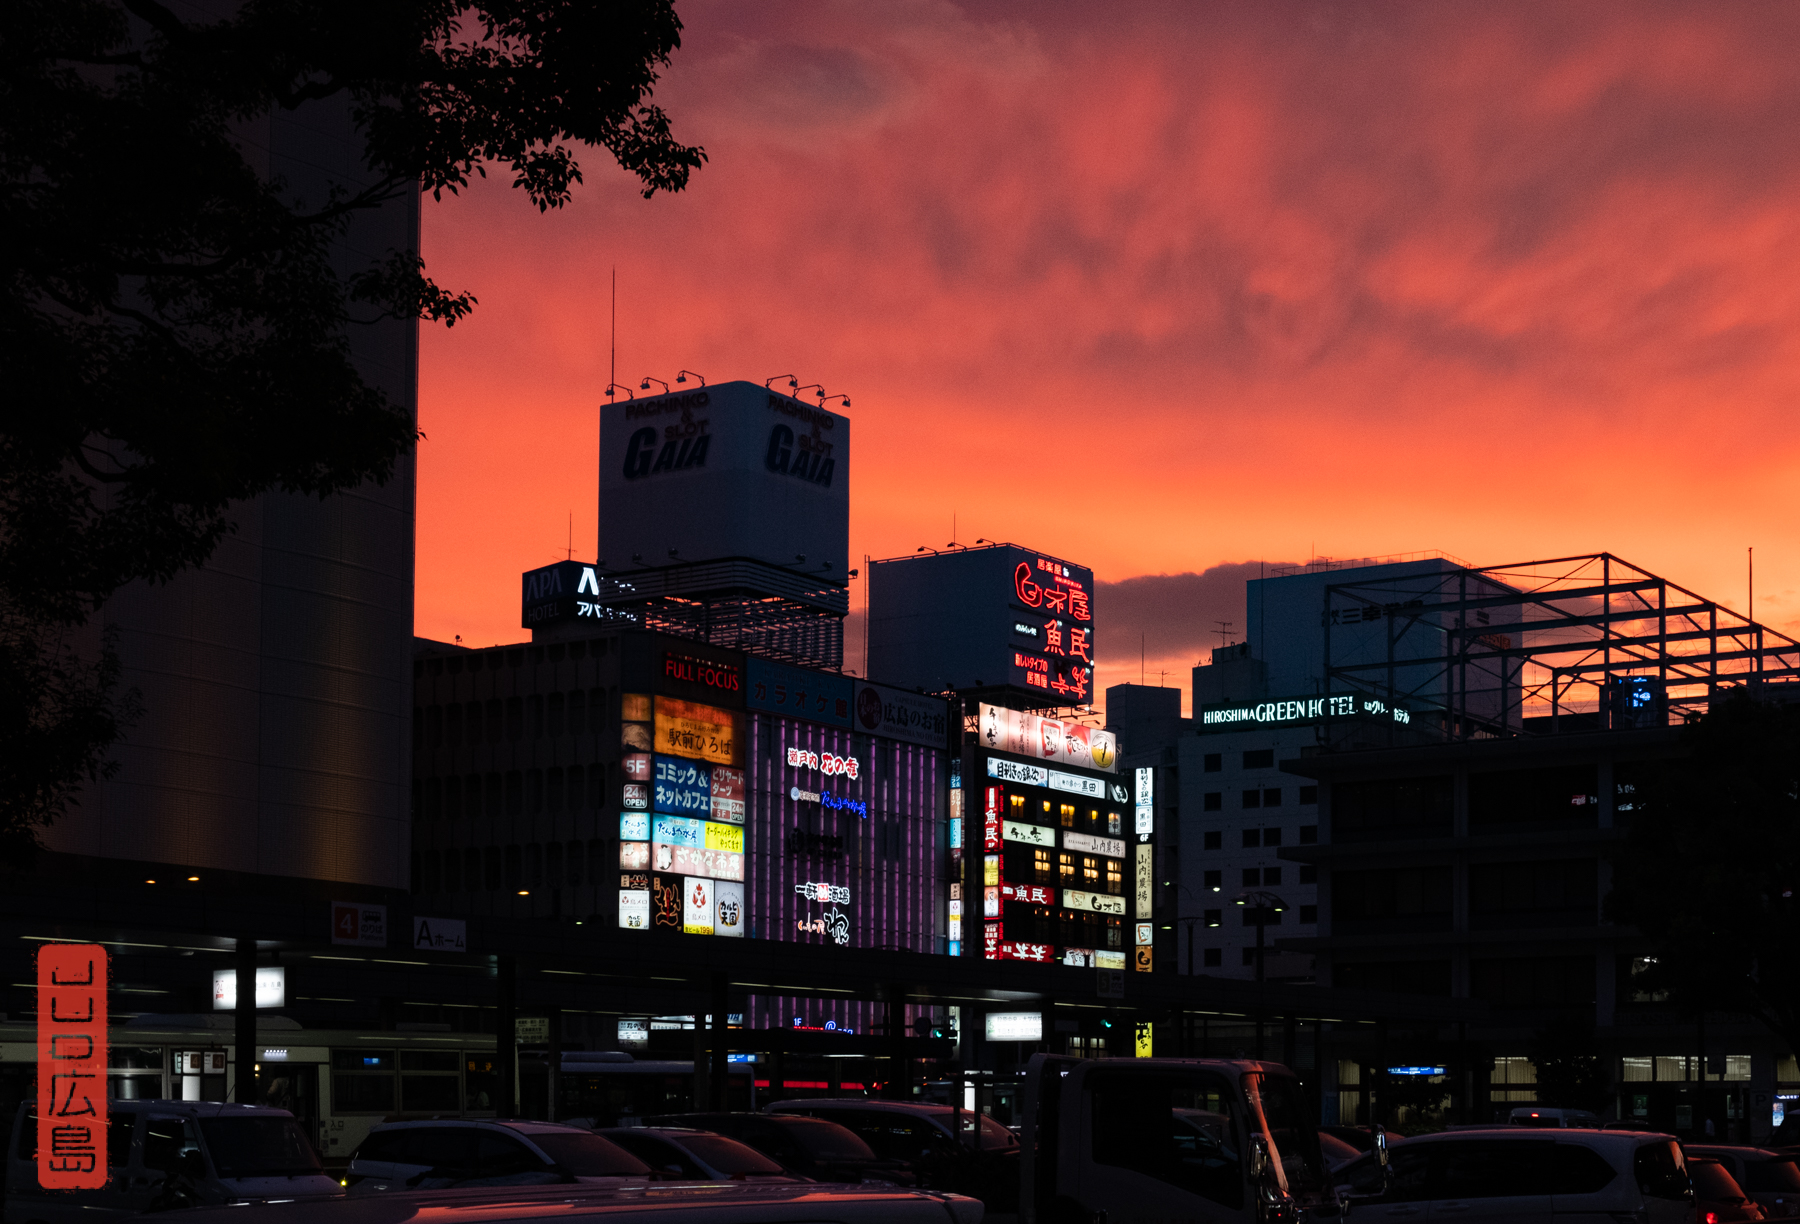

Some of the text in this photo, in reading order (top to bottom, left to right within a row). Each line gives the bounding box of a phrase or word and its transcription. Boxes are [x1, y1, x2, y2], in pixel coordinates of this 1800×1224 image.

[625, 392, 709, 420] PACHINKO
[767, 395, 834, 430] PACHINKO
[664, 420, 708, 439] SLOT
[623, 427, 711, 480] GAIA
[765, 424, 836, 488] GAIA
[798, 434, 834, 456] SLOT
[1015, 562, 1092, 621] 白木屋
[528, 601, 560, 623] HOTEL
[1044, 618, 1090, 664] 魚民
[665, 660, 695, 682] FULL
[697, 667, 739, 691] FOCUS
[1026, 670, 1048, 689] 居酒屋
[754, 681, 848, 719] カラオケ館
[883, 702, 945, 735] 広島のお宿
[1203, 709, 1256, 724] HIROSHIMA
[1255, 701, 1306, 722] GREEN
[668, 728, 733, 755] 駅前ひろば
[626, 759, 646, 774] 5F
[656, 762, 709, 788] コミック&
[712, 768, 744, 785] ビリヤード
[820, 752, 859, 780] 花の舞
[997, 761, 1040, 782] 目利きの銀次
[625, 787, 646, 798] 24H
[656, 785, 709, 811] ネットカフェ
[712, 782, 733, 797] ダーツ
[625, 798, 645, 807] OPEN
[732, 813, 743, 821] OPEN
[985, 809, 998, 842] 魚民
[1091, 837, 1121, 855] 山内農場
[1139, 834, 1149, 842] 6F
[676, 847, 740, 871] さかな市場
[1137, 853, 1148, 902] 山内農場
[1014, 884, 1047, 905] 魚民
[339, 913, 354, 935] 4
[361, 924, 383, 934] のりば
[721, 911, 737, 926] 天国
[1012, 942, 1046, 961] 笑笑
[793, 1017, 802, 1026] 1F
[1755, 1094, 1767, 1107] P
[330, 1120, 344, 1128] 入口
